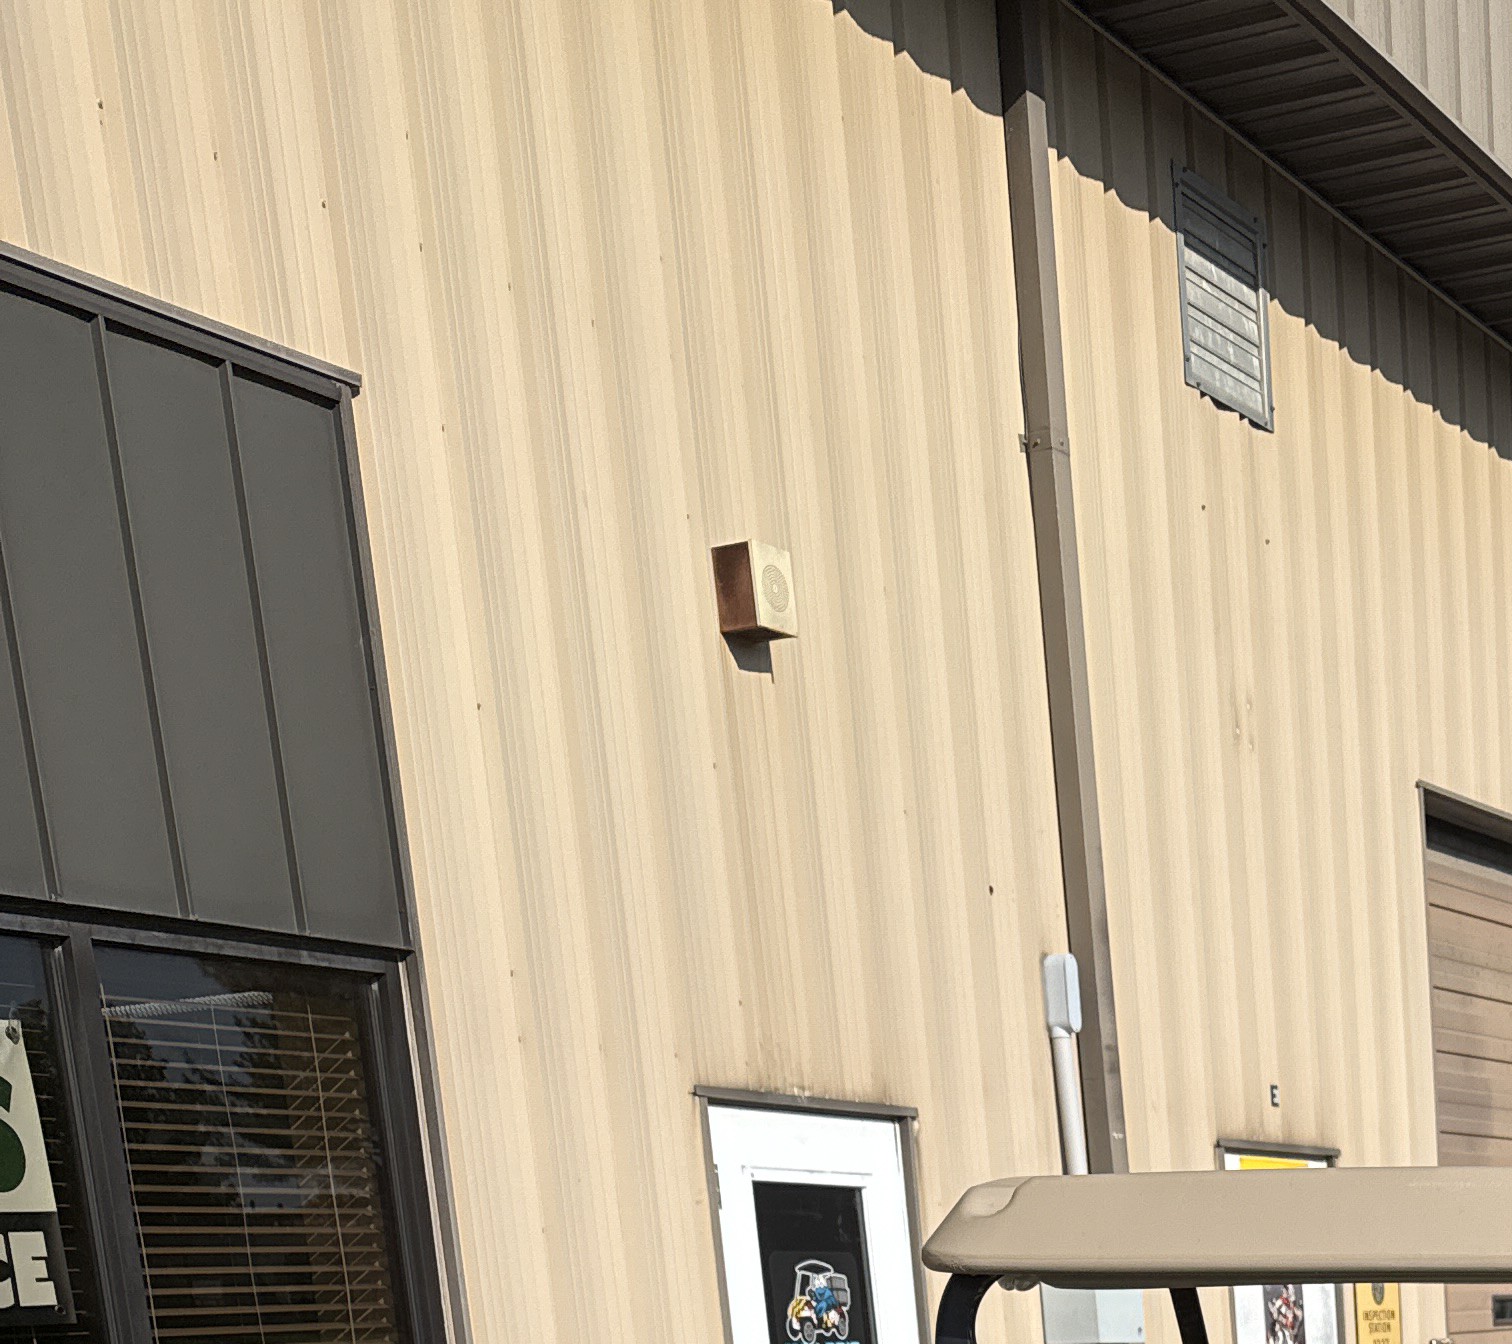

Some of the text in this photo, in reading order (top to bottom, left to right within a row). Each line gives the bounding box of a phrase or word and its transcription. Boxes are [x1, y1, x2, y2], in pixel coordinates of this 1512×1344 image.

[1270, 1084, 1280, 1107] E
[1362, 1309, 1396, 1321] INSPECTION
[1368, 1322, 1391, 1334] STATION
